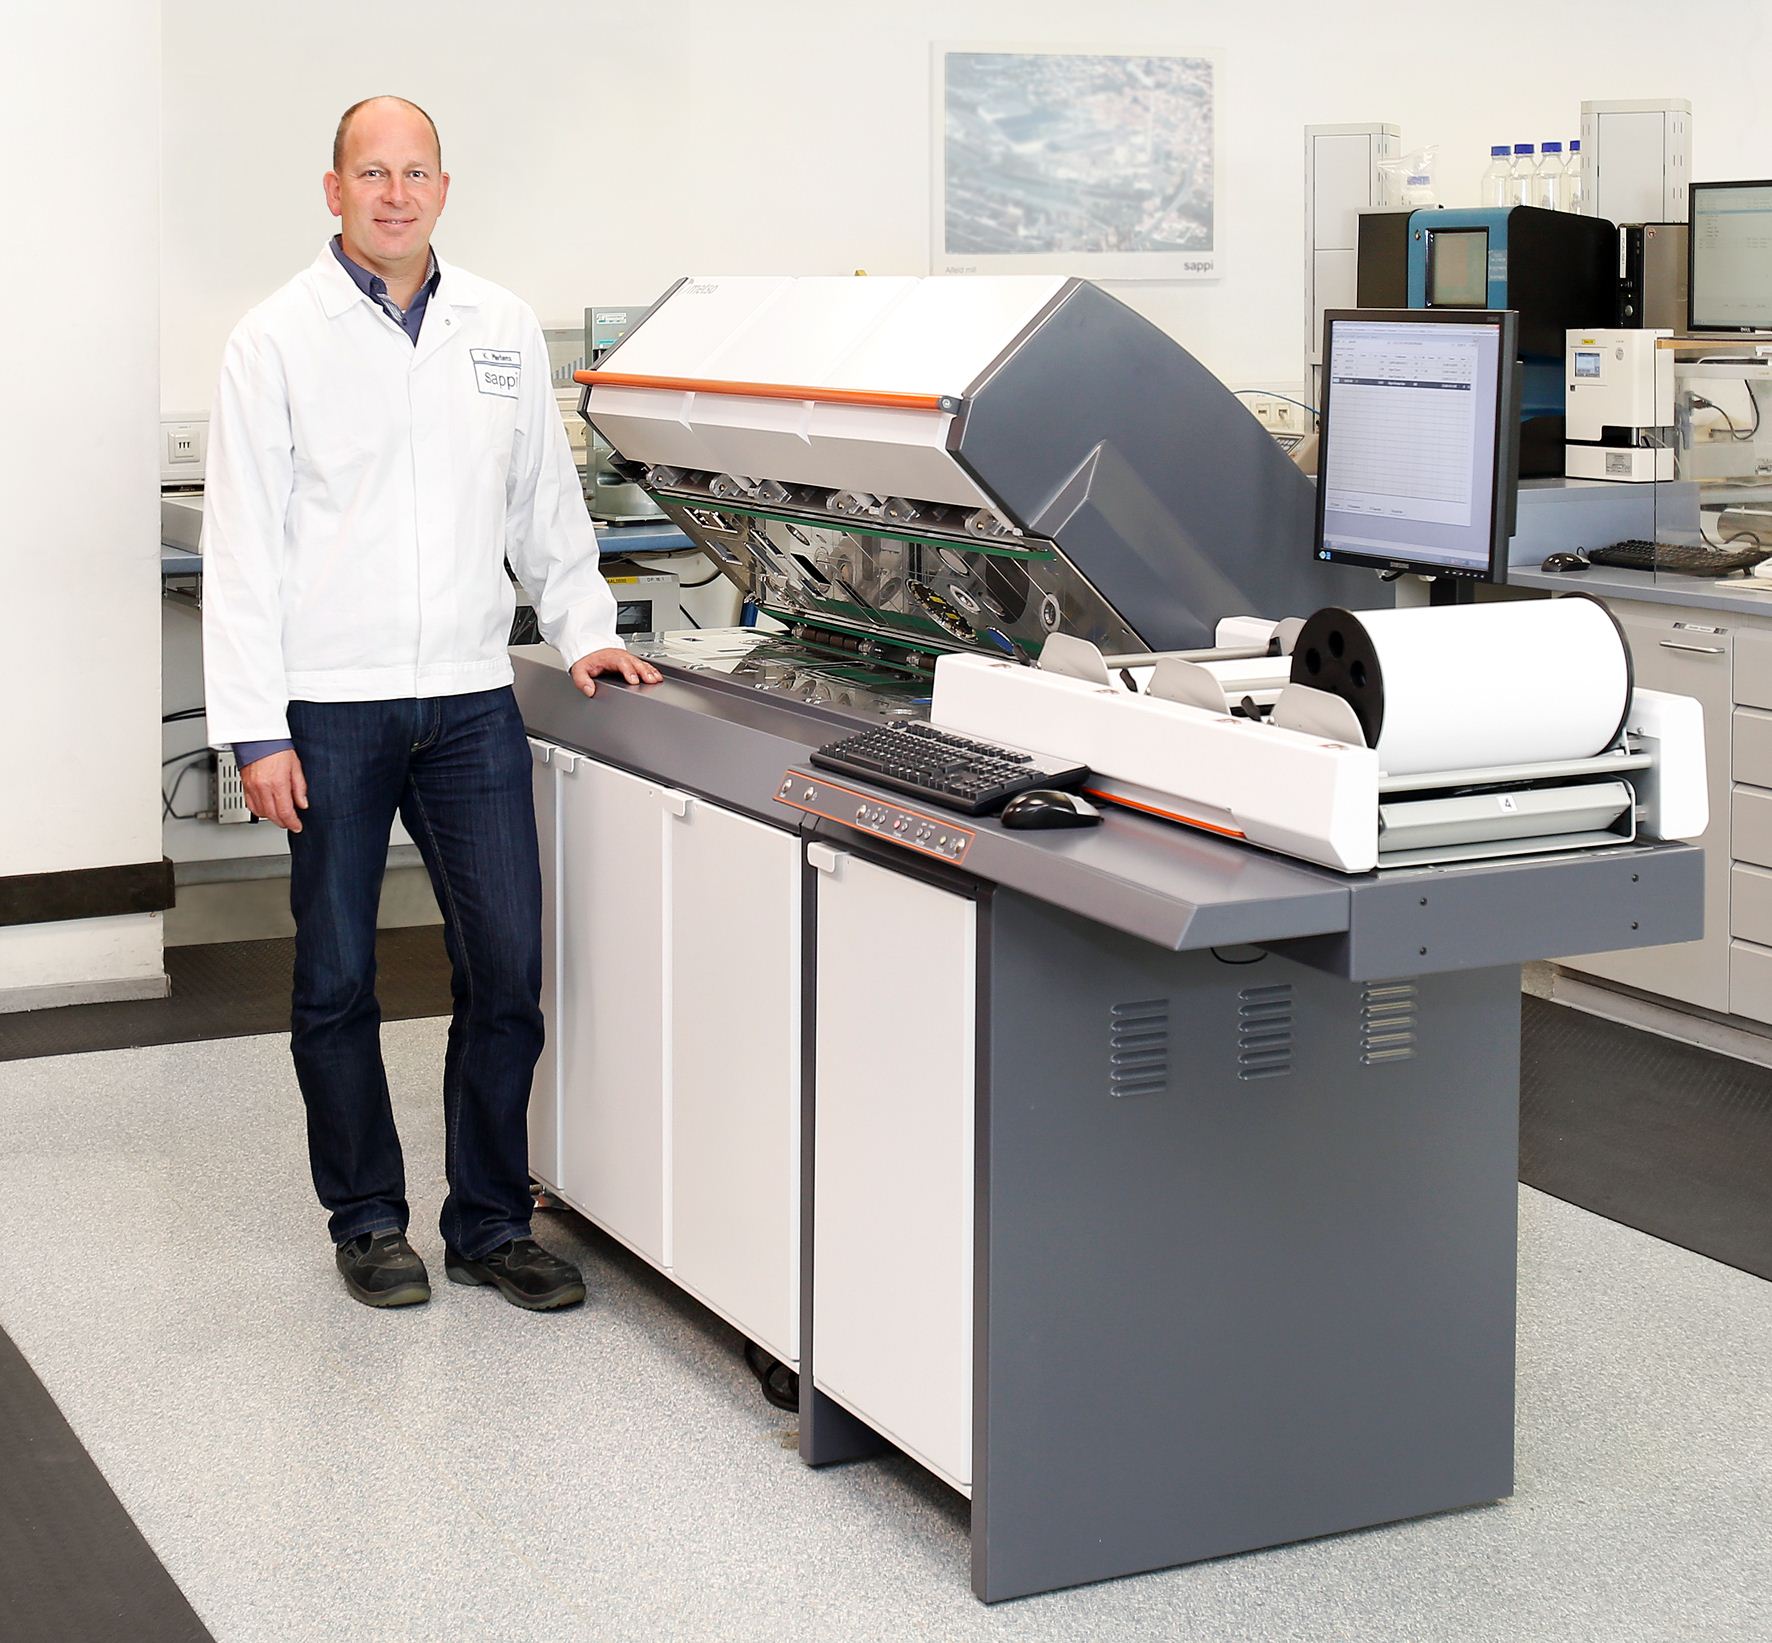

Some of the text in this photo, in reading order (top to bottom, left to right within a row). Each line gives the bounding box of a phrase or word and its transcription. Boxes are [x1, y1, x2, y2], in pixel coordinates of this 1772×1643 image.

[1184, 259, 1214, 273] sappi
[484, 372, 518, 390] sappi
[1504, 798, 1512, 808] 4
